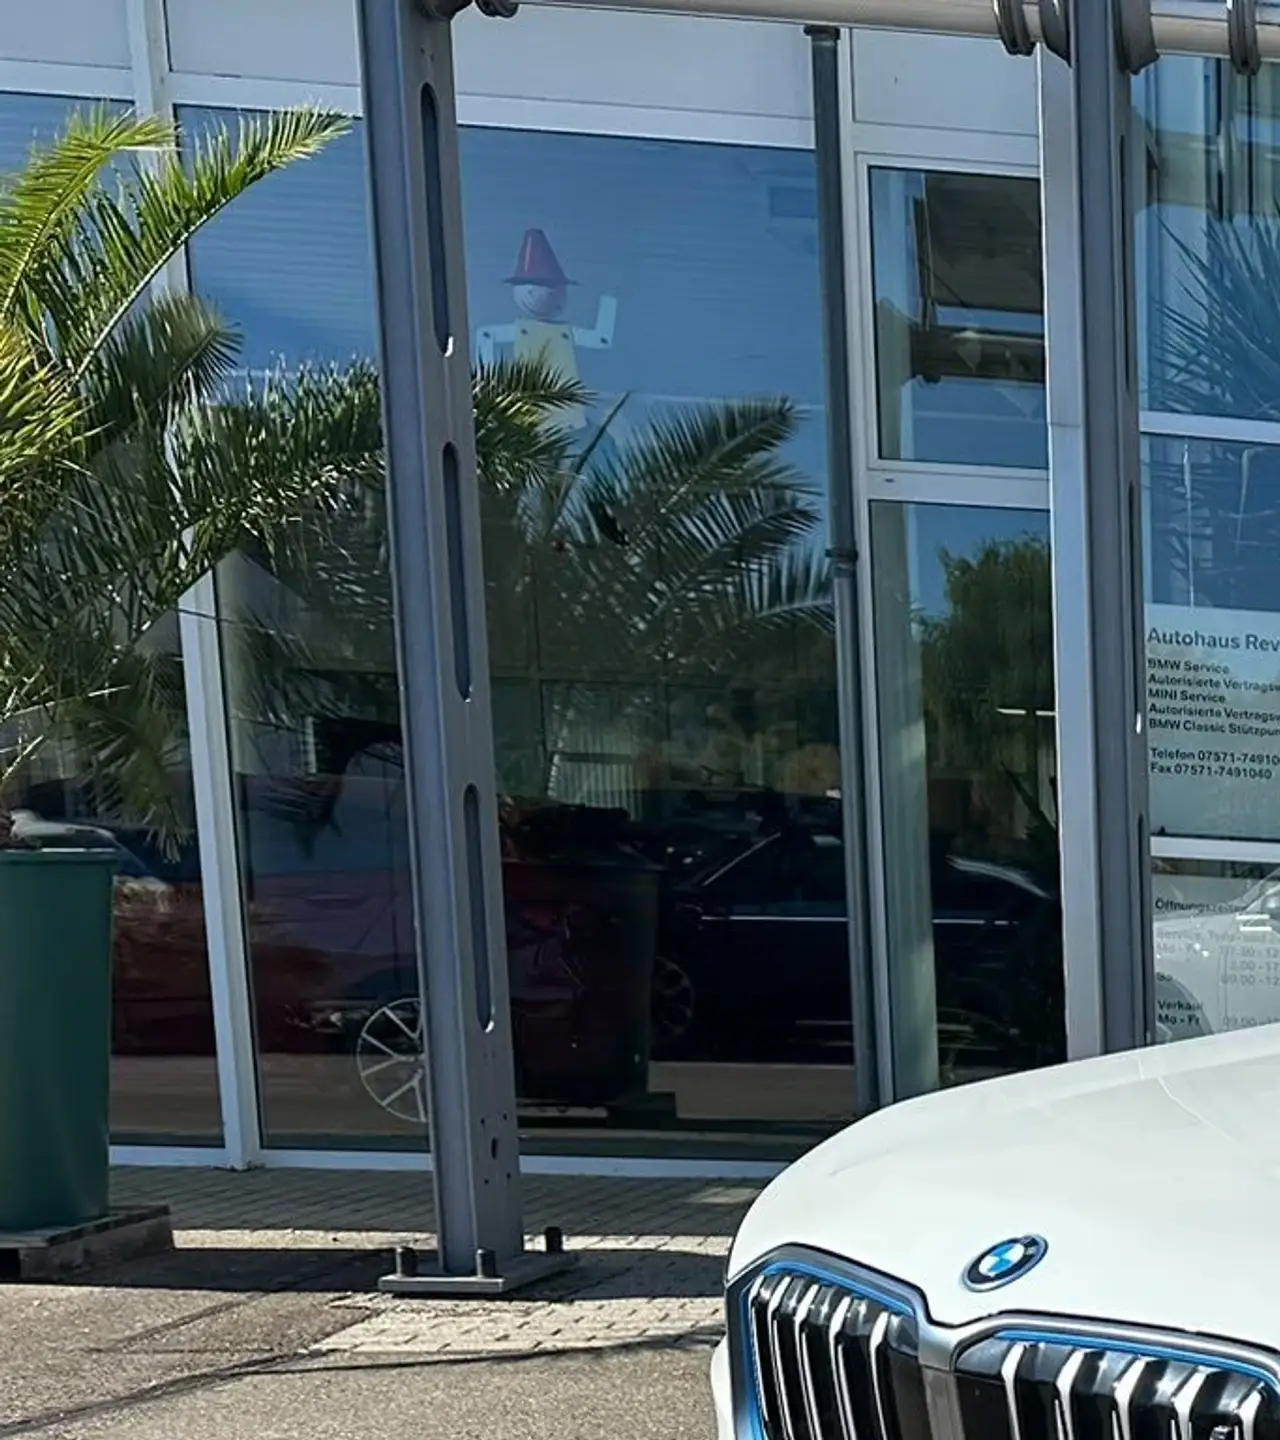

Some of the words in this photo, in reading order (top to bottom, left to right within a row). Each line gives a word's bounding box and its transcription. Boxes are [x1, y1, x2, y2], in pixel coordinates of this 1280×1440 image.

[1147, 628, 1240, 649] Autohaus
[1148, 658, 1180, 670] BMW
[1184, 660, 1230, 674] Service
[1148, 674, 1222, 688] Autorisierte
[1148, 689, 1177, 701] MINI
[1180, 690, 1226, 703] Service
[1149, 704, 1221, 718] Autorisierte
[1149, 719, 1180, 731] BMW
[1183, 720, 1225, 734] Classic
[1150, 748, 1195, 760] Telefon
[1150, 762, 1171, 773] Fax
